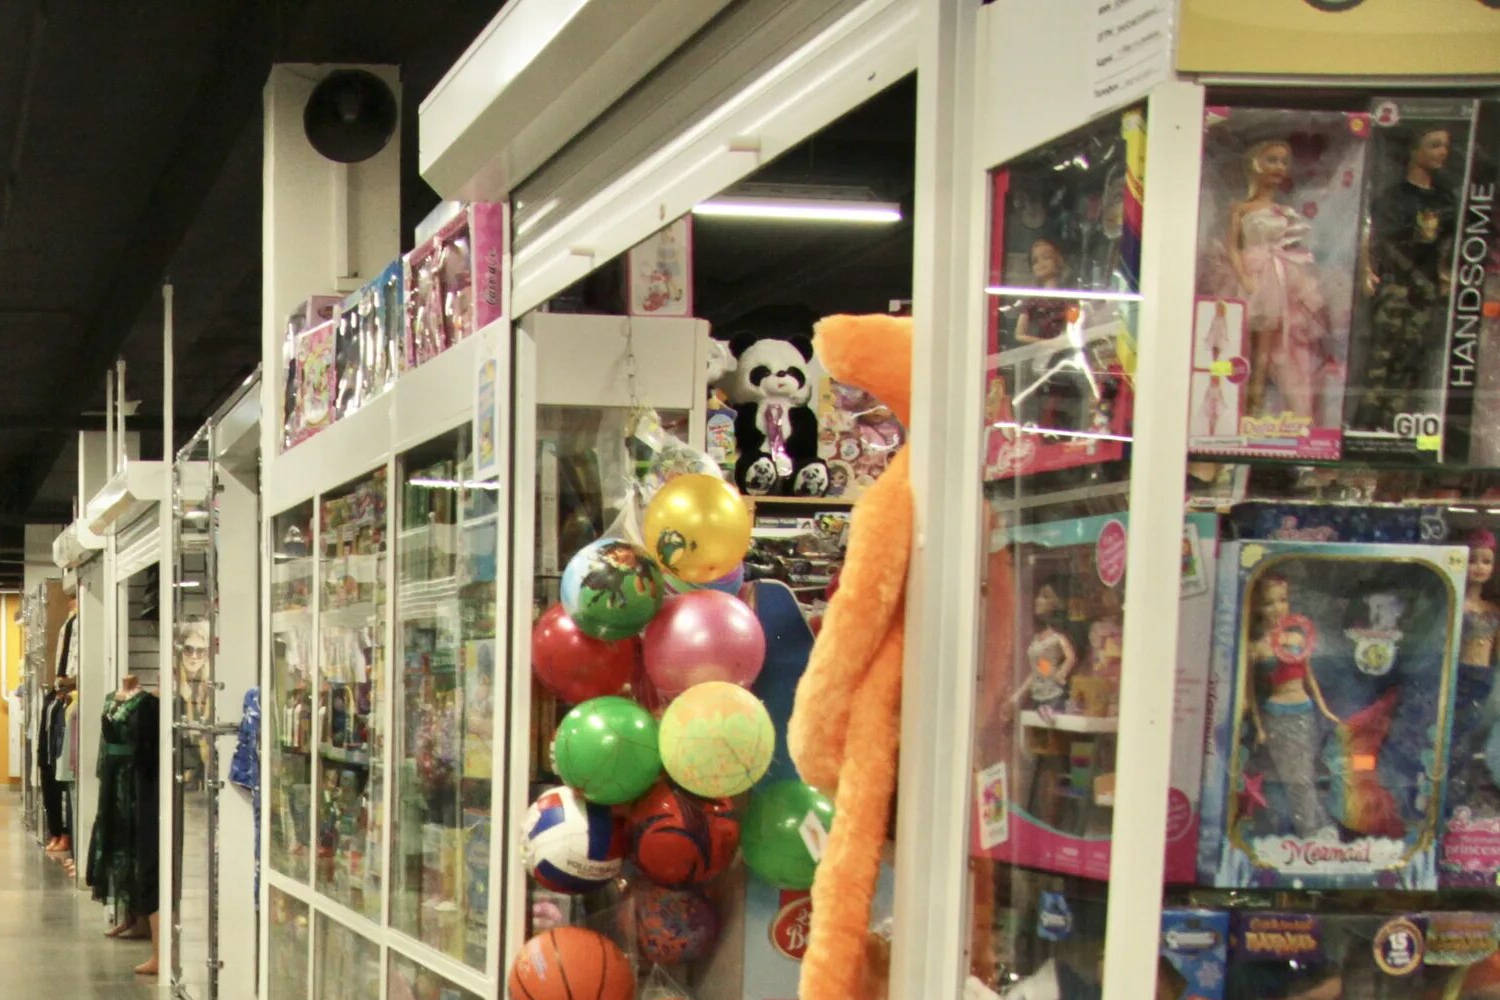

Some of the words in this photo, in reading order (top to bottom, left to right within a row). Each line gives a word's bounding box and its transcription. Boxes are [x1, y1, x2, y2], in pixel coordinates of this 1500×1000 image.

[1450, 182, 1495, 387] HANDSOME
[1394, 413, 1442, 437] GIO
[1281, 840, 1371, 866] Mermaid
